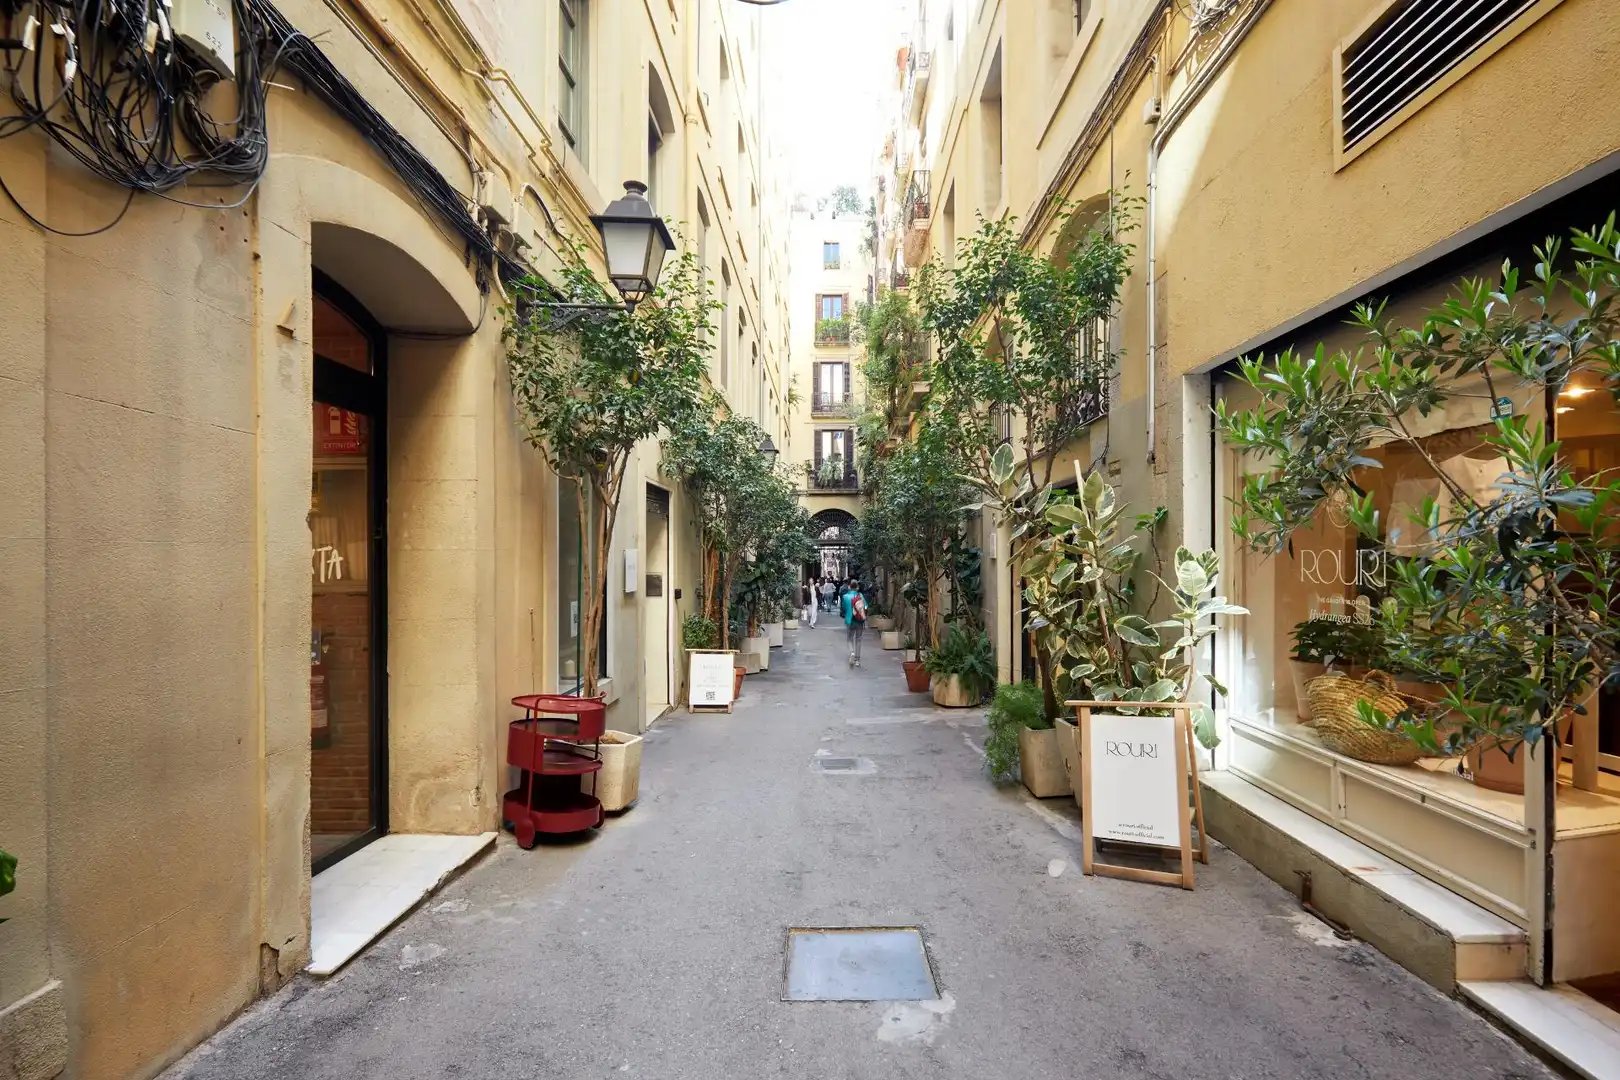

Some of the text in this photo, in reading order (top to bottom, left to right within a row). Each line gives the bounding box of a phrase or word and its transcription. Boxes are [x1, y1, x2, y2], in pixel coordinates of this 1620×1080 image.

[1300, 548, 1387, 588] ROURI
[1309, 608, 1351, 626] Hydrangea
[1106, 741, 1158, 759] ROURI
